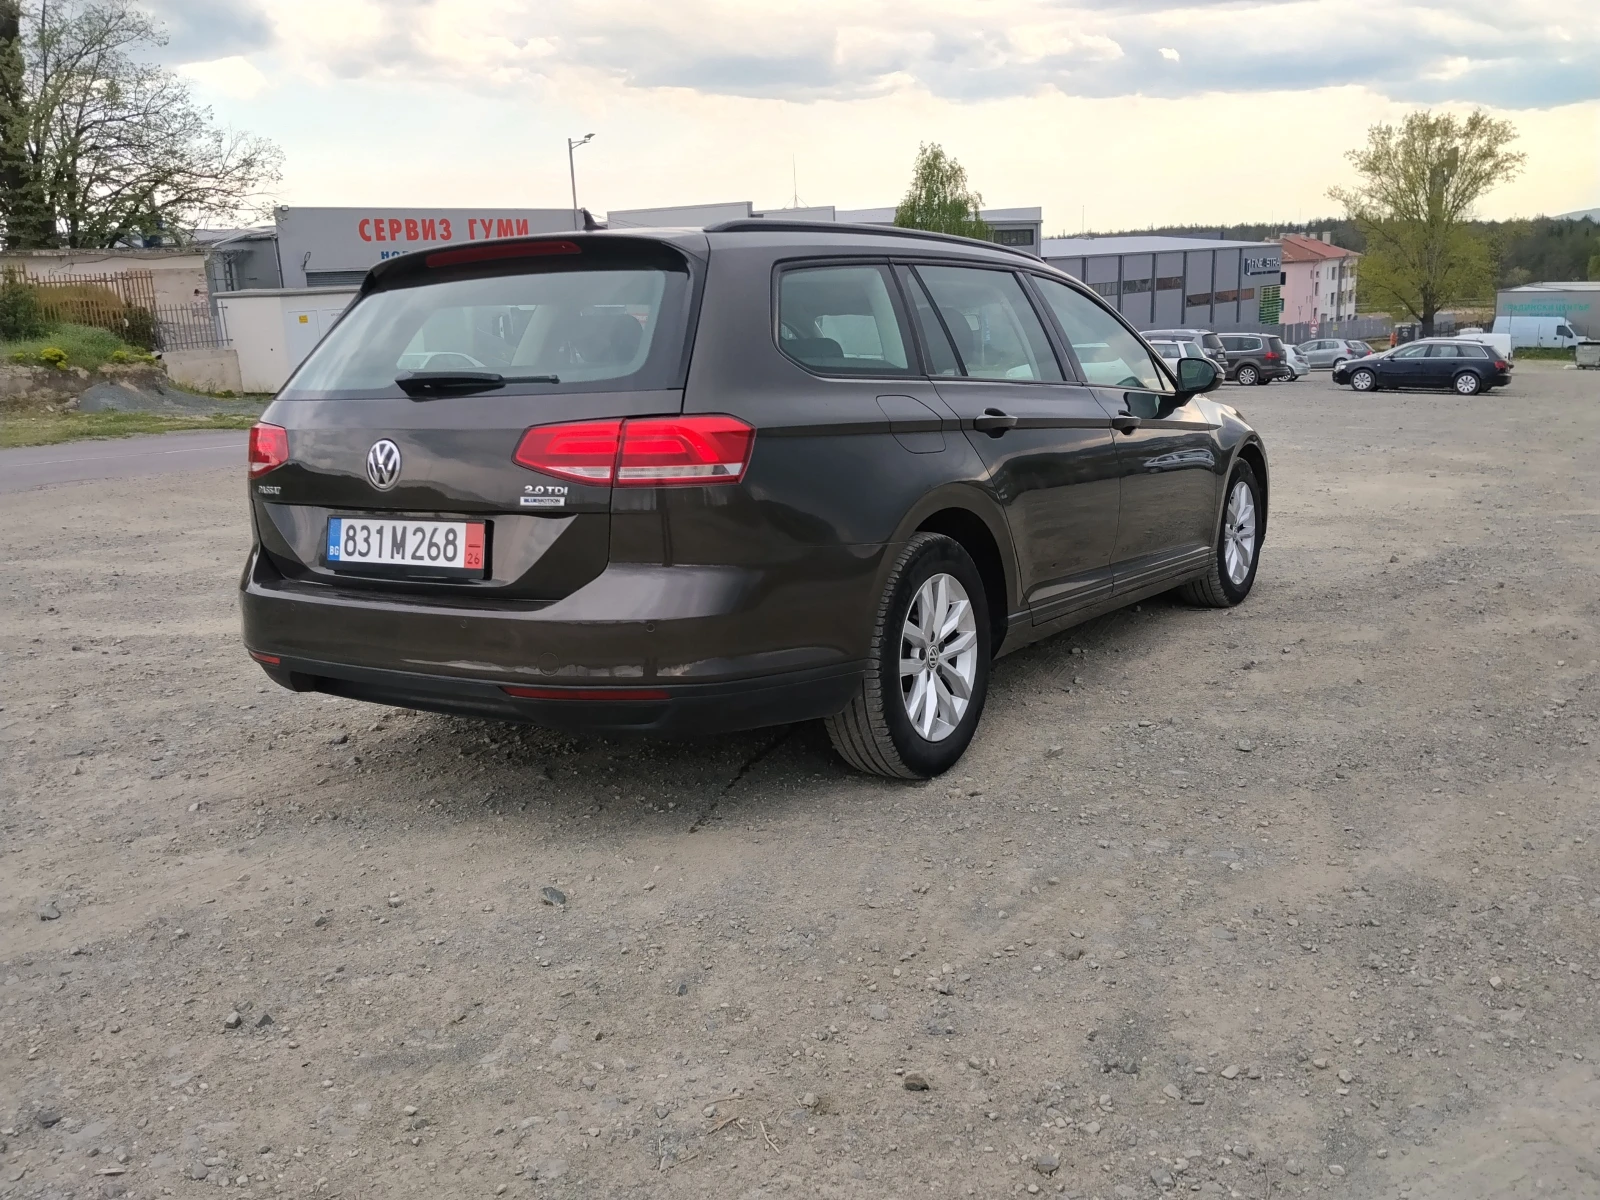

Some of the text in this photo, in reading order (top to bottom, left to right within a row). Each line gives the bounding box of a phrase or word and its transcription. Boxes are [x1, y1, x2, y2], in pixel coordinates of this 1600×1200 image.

[358, 218, 529, 242] СЕРВИЗ ГУМИ
[546, 486, 569, 496] TDI
[329, 546, 340, 556] BG
[467, 552, 480, 565] 26
